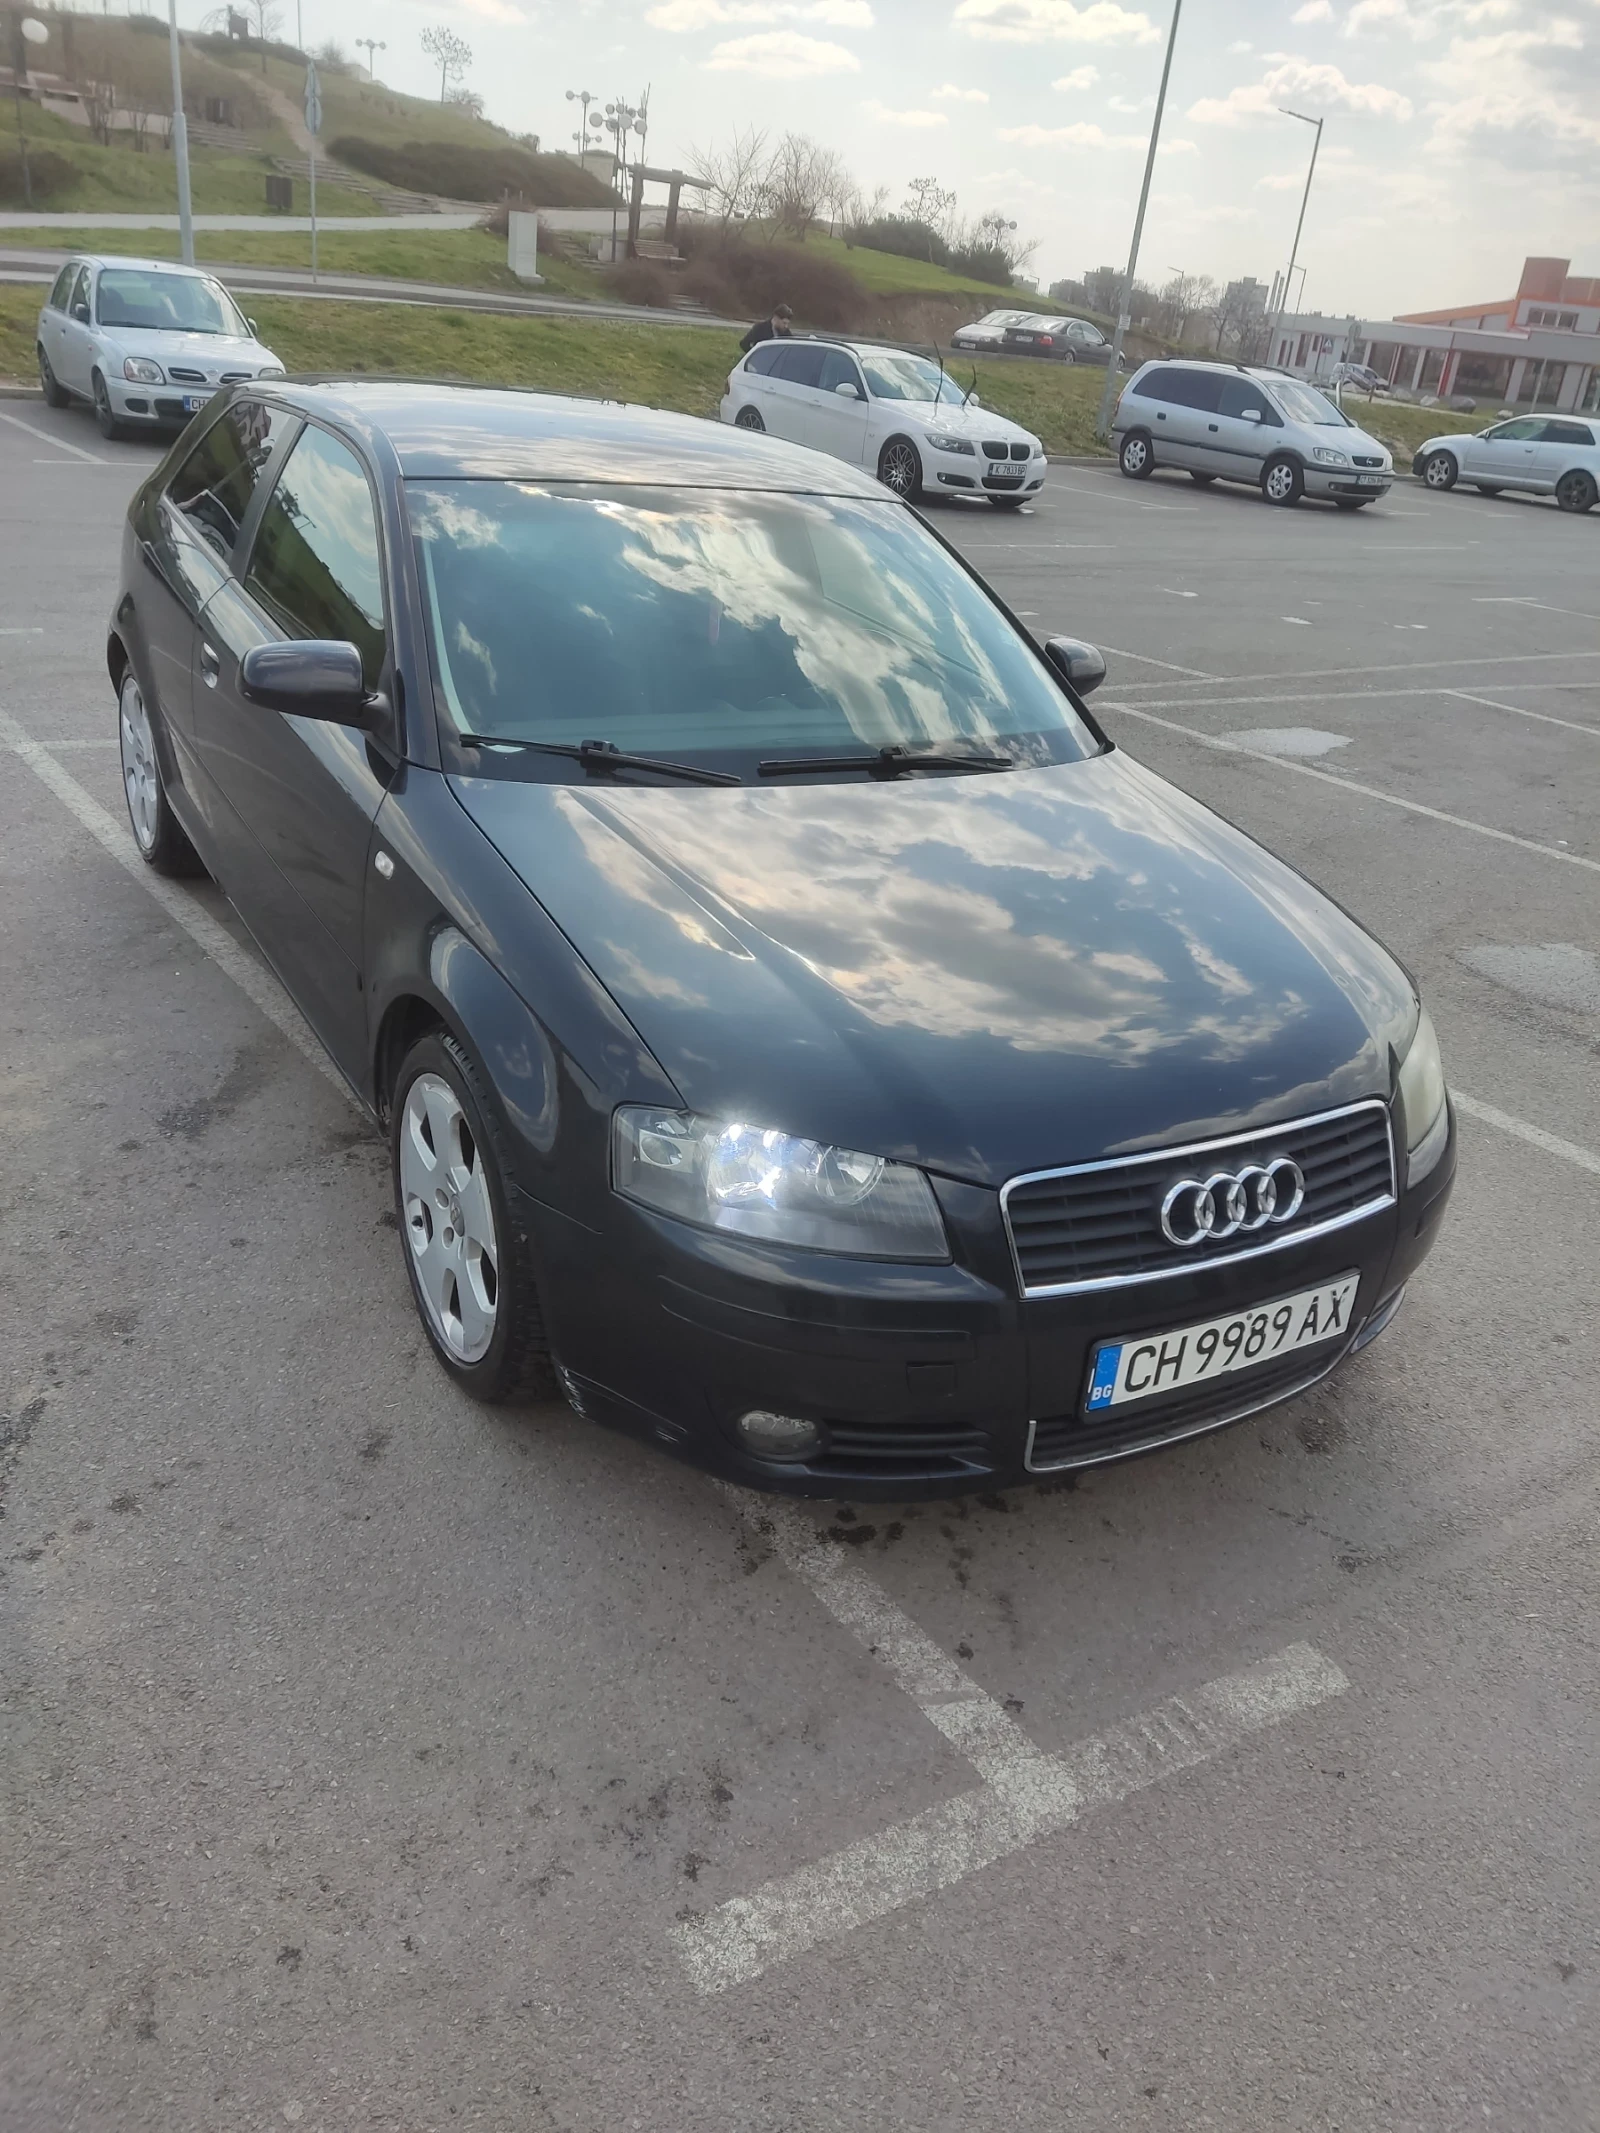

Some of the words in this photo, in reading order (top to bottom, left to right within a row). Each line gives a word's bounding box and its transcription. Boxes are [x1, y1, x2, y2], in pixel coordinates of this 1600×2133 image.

[1124, 1335, 1189, 1393] CH
[1196, 1305, 1293, 1374] 9989
[1296, 1286, 1350, 1342] AX
[1091, 1384, 1112, 1401] BG
